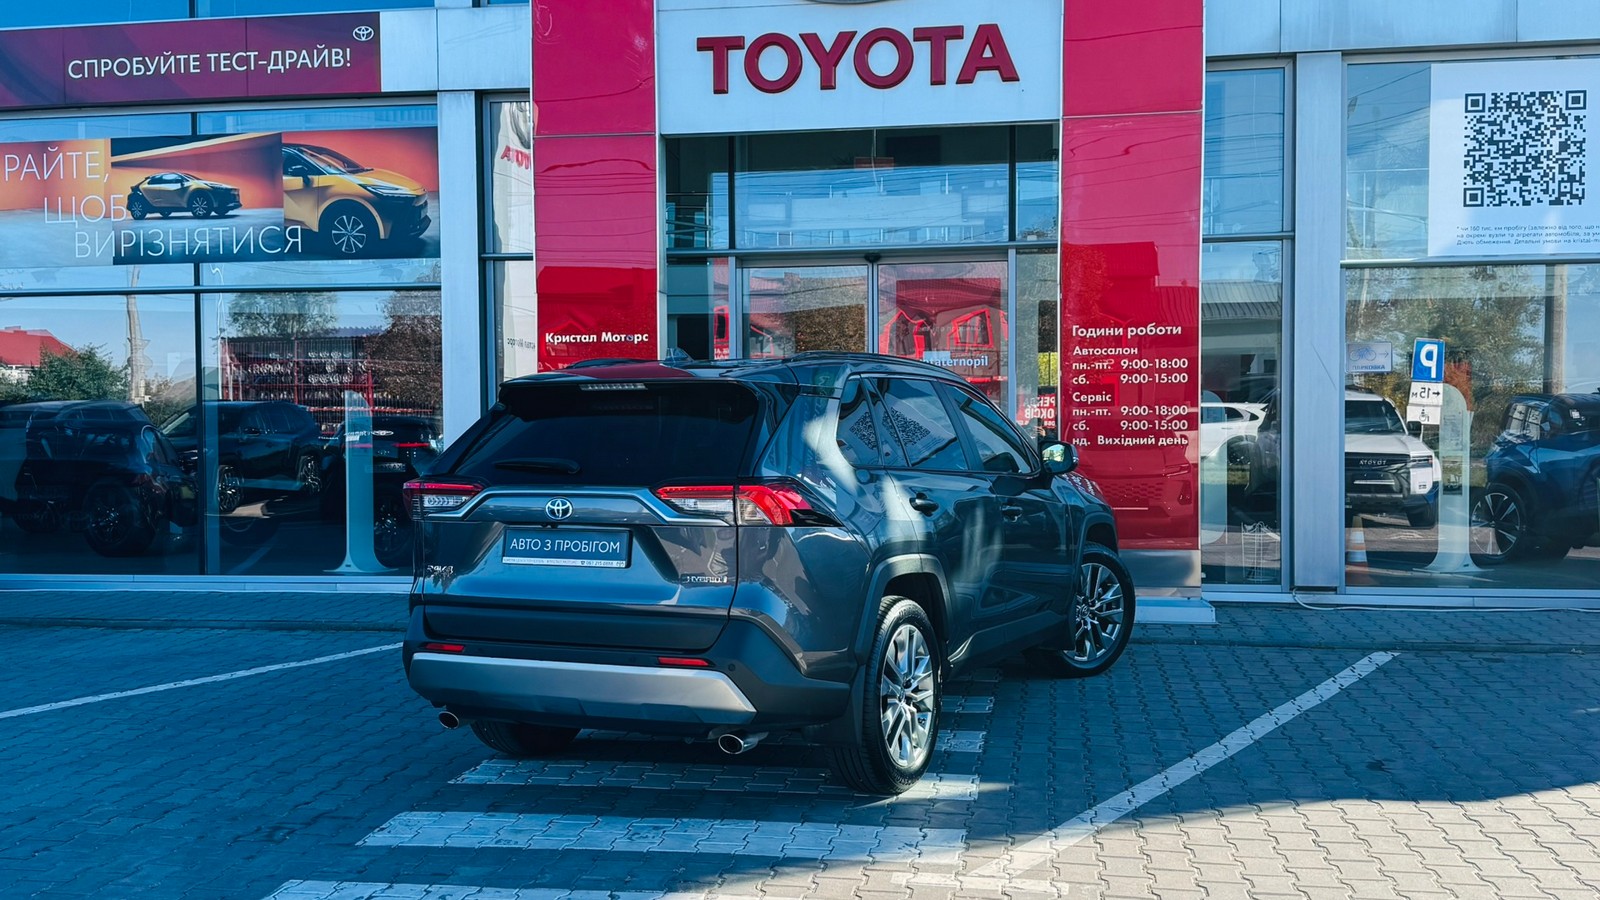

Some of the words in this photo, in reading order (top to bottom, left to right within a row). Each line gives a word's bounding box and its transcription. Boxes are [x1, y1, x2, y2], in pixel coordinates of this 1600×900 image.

[68, 52, 200, 79] СПРОБУЙТЕ
[207, 45, 351, 75] ТЕСТ-ДРАЙВ!
[697, 23, 1020, 94] TOYOTA
[4, 147, 110, 183] РАЙТЕ,
[43, 195, 127, 228] ЩОБ
[75, 226, 302, 258] ВИРІЗНЯТИСЯ
[1072, 325, 1123, 338] Години
[1128, 323, 1182, 338] роботи
[545, 332, 597, 344] Кристал
[601, 332, 648, 344] Моторс
[1073, 346, 1138, 356] Автосалон
[1072, 362, 1112, 370] пн.-пт.
[1120, 359, 1188, 370] 9:00-18:00
[1072, 375, 1090, 385] сб.
[1120, 373, 1188, 384] 9:00-15:00
[1072, 391, 1112, 404] Сервіс
[1120, 406, 1188, 416] 9:00-18:00
[1072, 421, 1090, 430] сб.
[1120, 420, 1188, 430] 9:00-15:00
[1072, 437, 1090, 446] нд.
[1098, 434, 1156, 446] Вихідний
[1158, 436, 1188, 448] день
[510, 538, 541, 550] АВТО
[554, 540, 620, 554] ПРОБІГОМ
